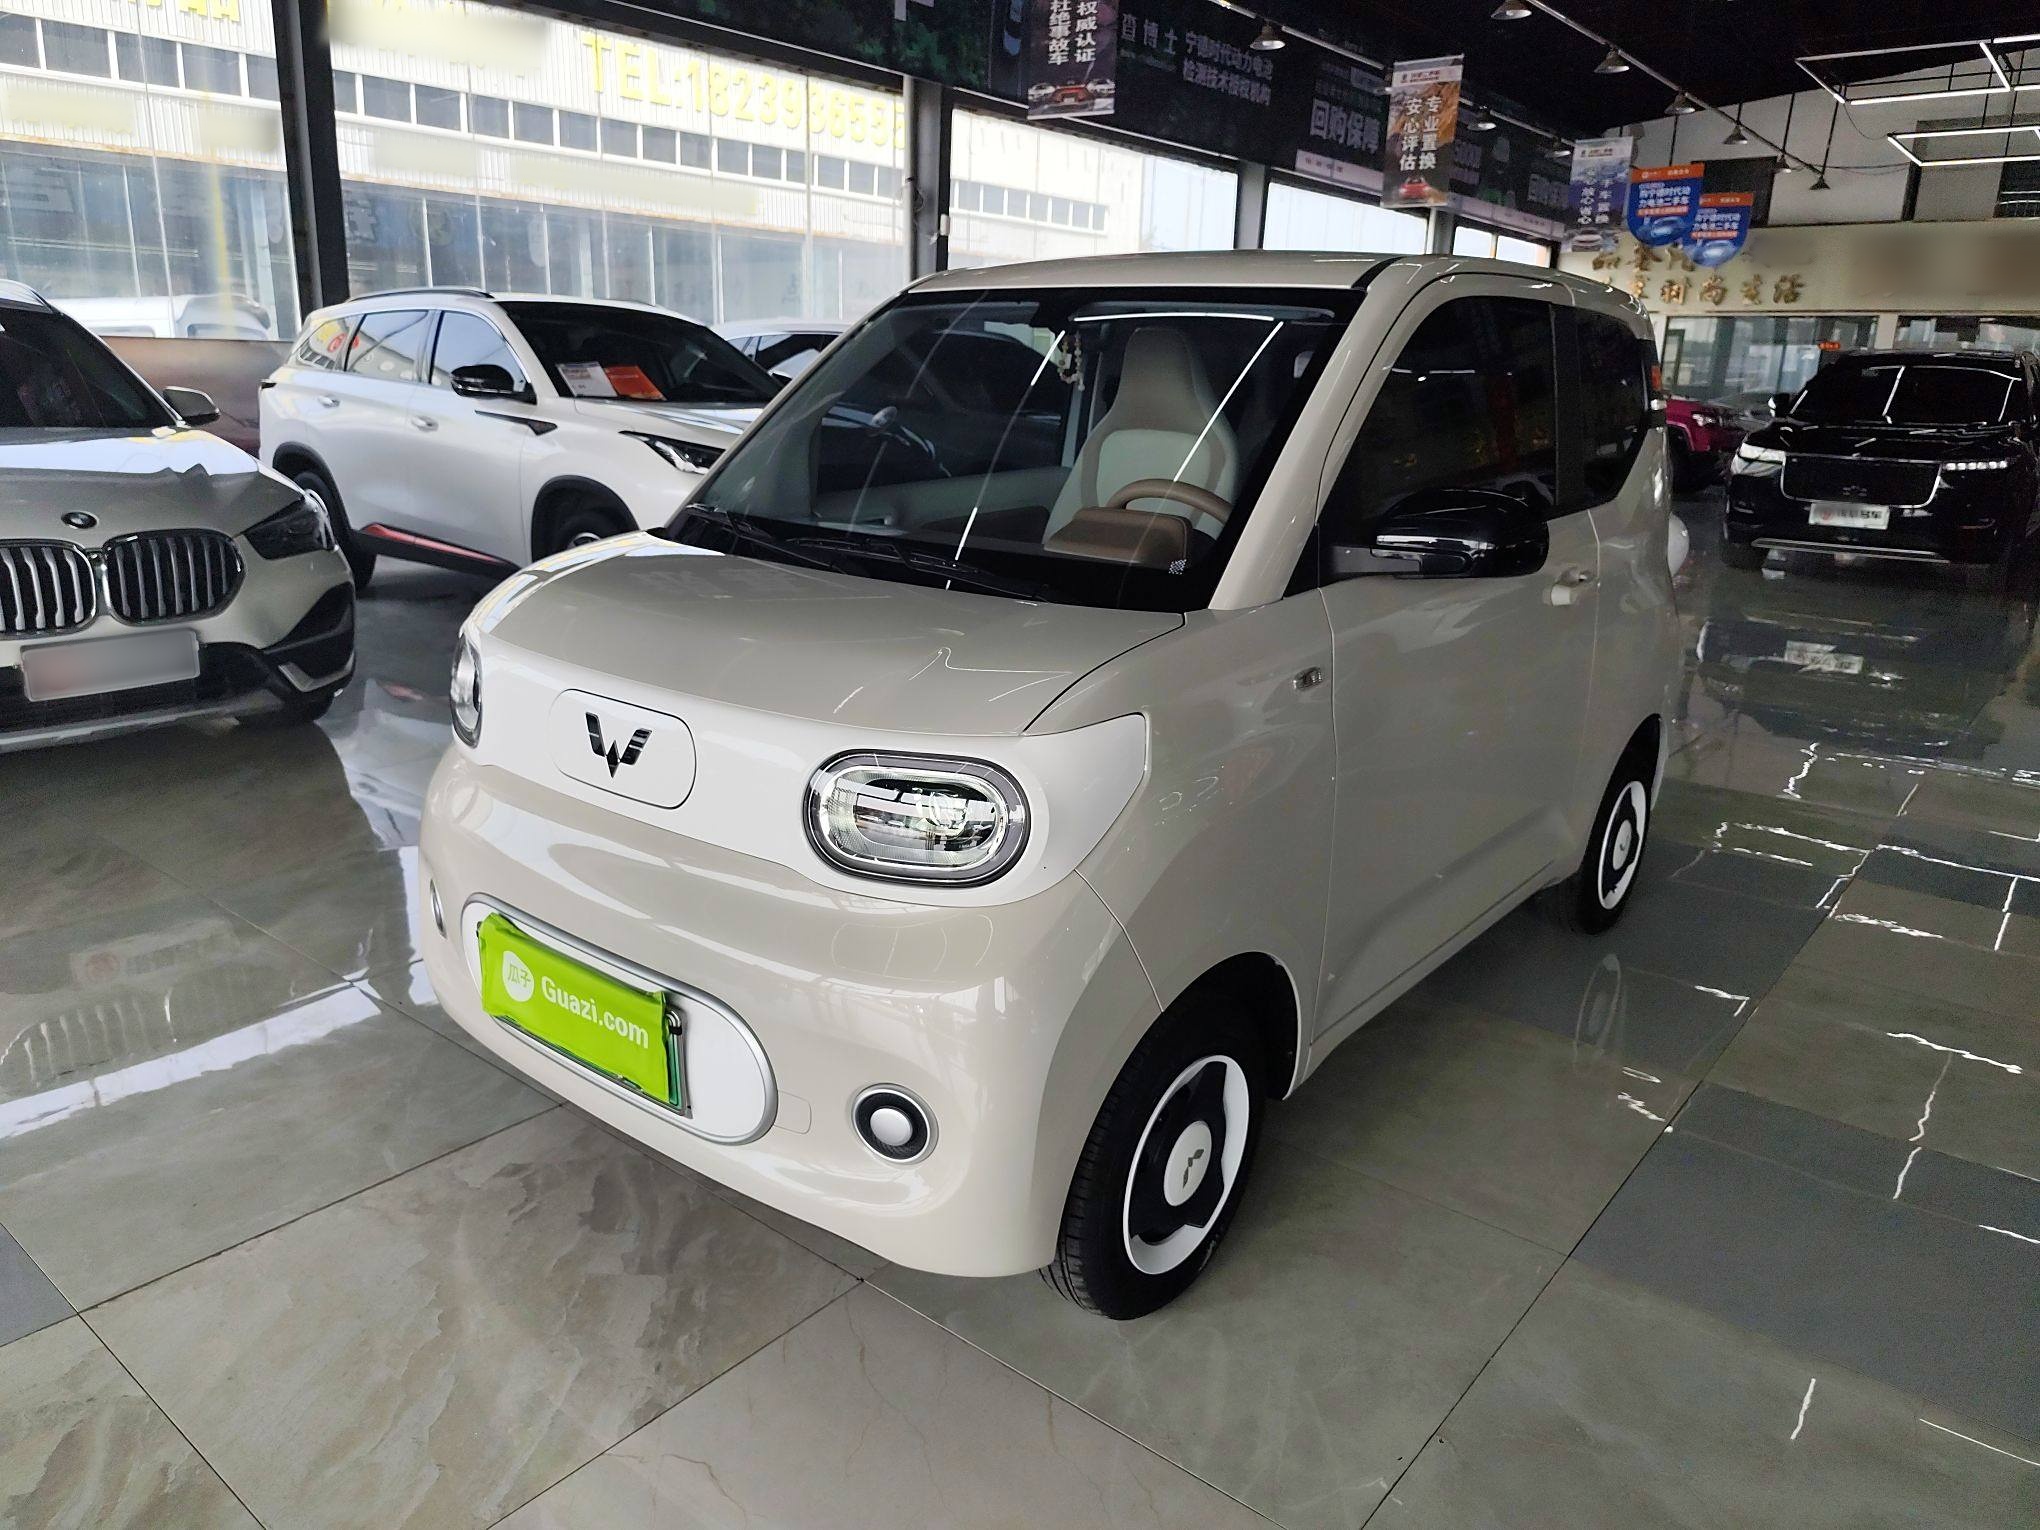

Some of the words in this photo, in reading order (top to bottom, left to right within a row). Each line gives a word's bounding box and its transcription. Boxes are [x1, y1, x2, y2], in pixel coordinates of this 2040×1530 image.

[1074, 1, 1098, 63] 权威认证
[1399, 97, 1423, 172] 安心评估
[1419, 95, 1443, 170] 专业置换
[507, 963, 532, 988] 瓜子
[541, 976, 649, 1049] Guazi.com
